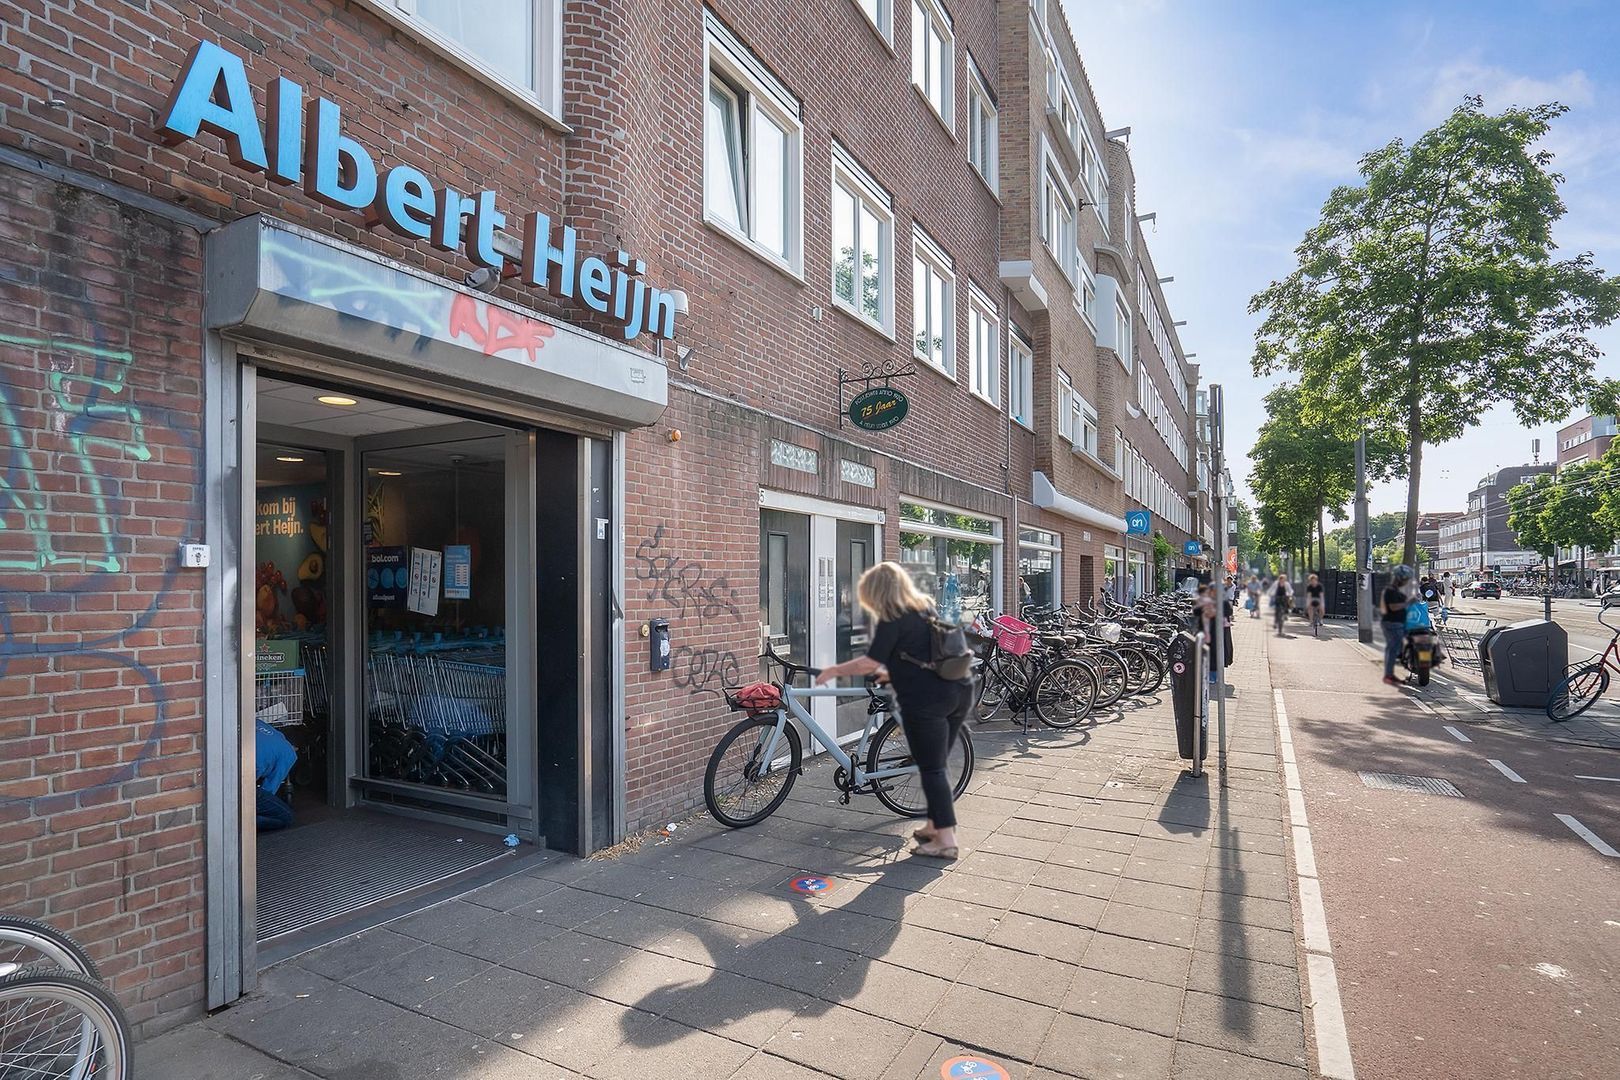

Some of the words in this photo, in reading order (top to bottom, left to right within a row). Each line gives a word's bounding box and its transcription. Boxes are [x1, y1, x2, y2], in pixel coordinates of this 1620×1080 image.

[160, 39, 506, 268] Albert
[526, 211, 676, 340] Heijn
[860, 404, 873, 418] 75
[875, 400, 897, 416] Jaar
[282, 496, 296, 518] bij
[273, 516, 304, 538] Heijn.
